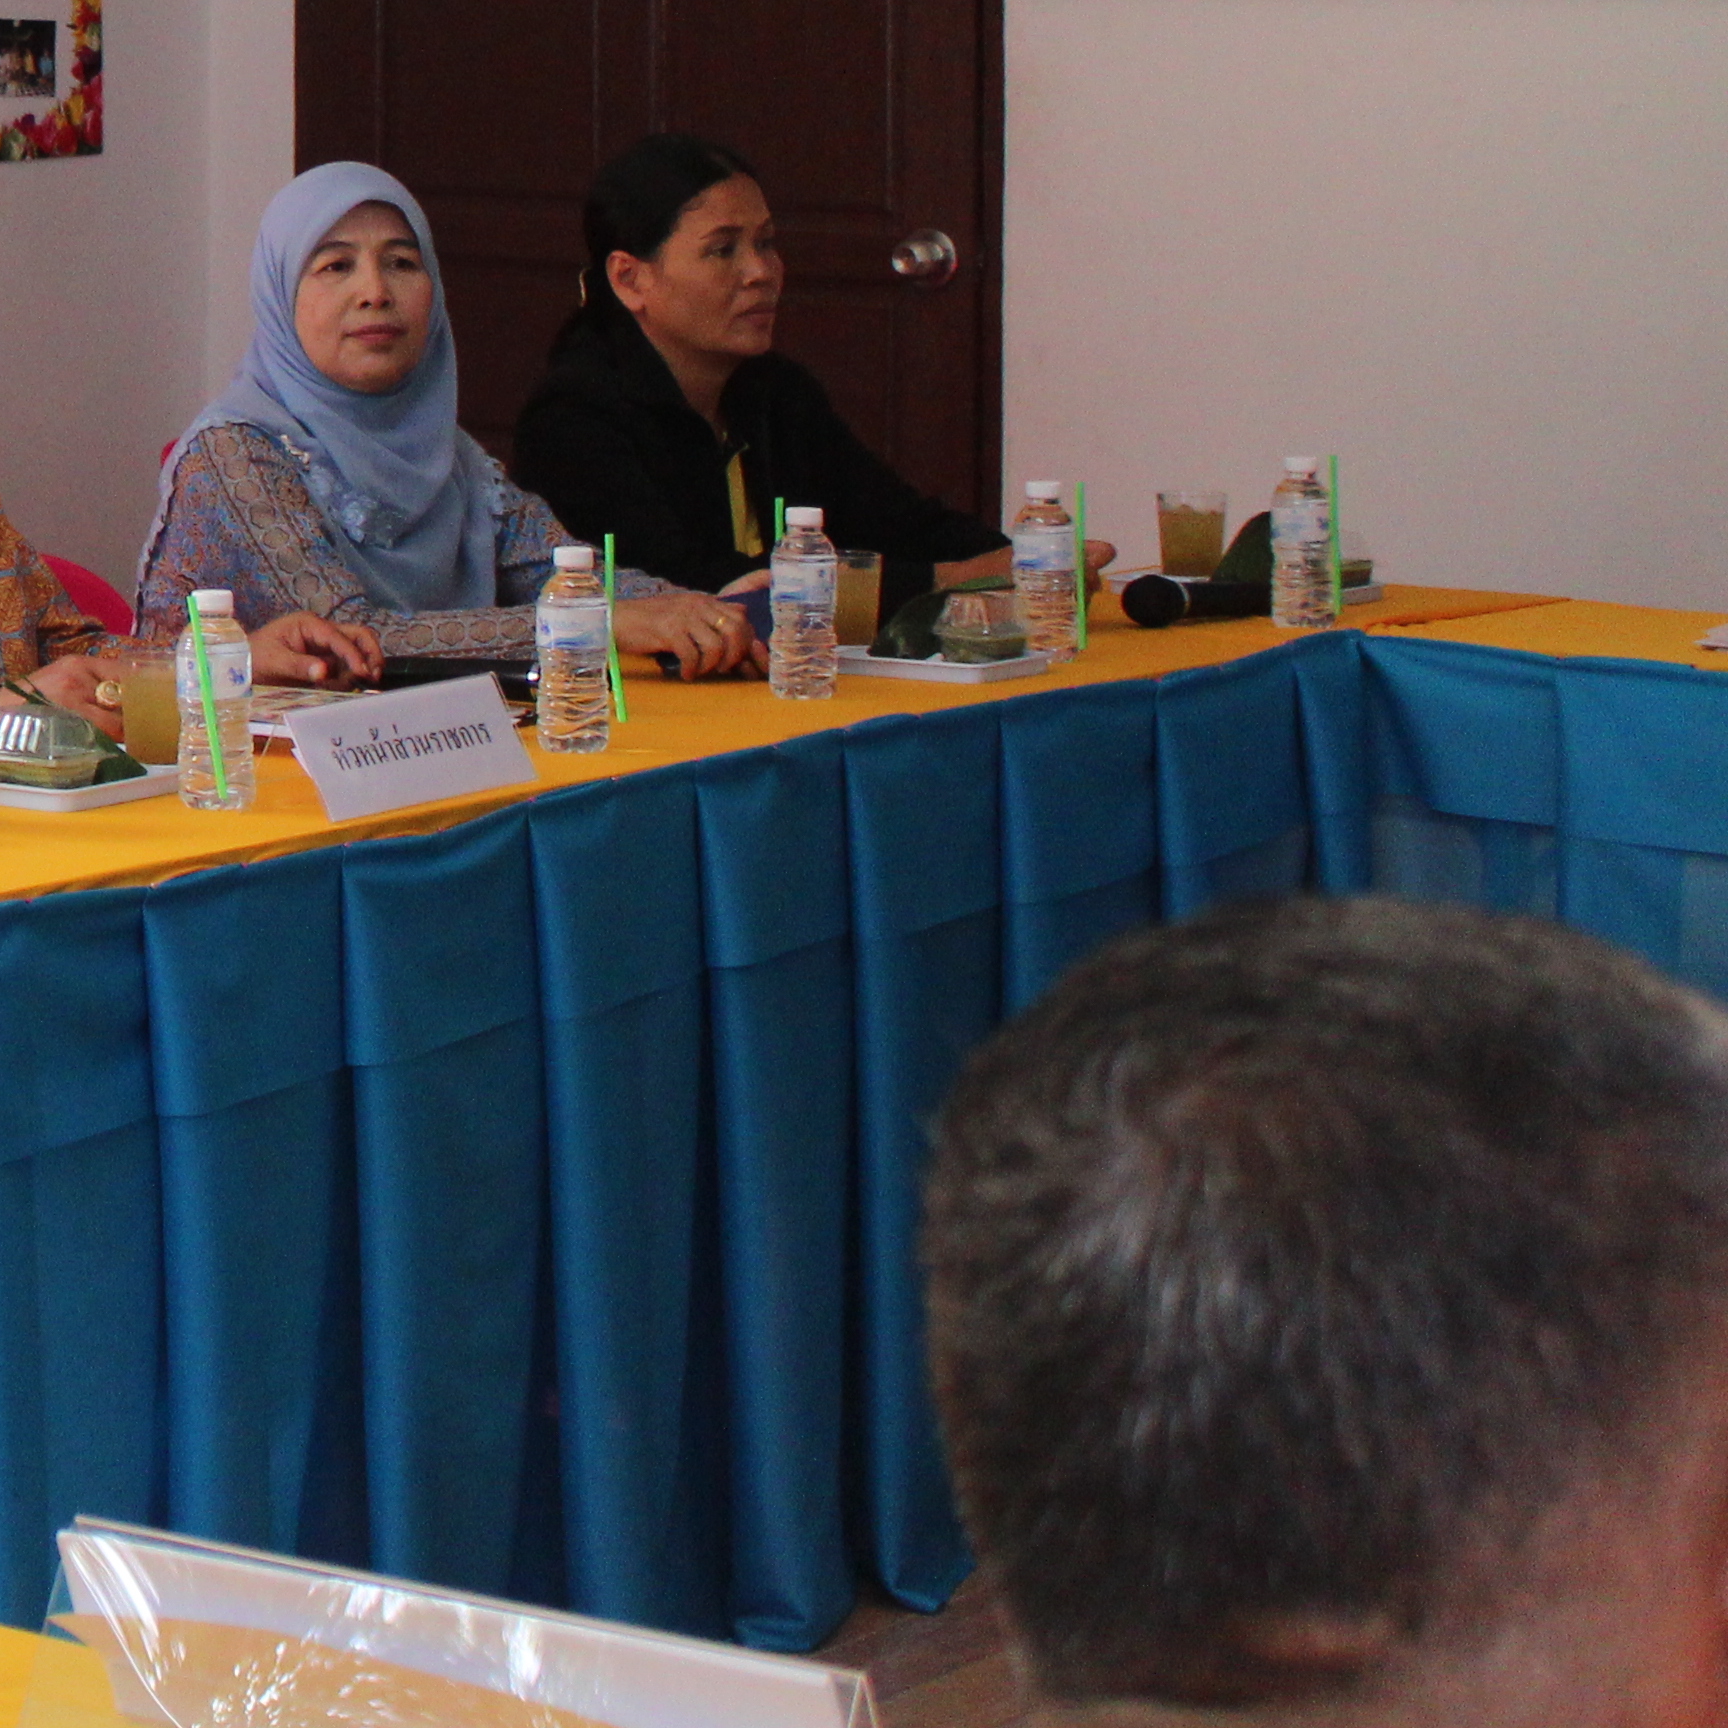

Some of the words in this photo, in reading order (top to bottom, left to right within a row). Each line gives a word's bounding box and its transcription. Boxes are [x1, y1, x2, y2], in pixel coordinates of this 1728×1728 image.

[331, 722, 494, 772] หัวหน้าส่วนราชการ
